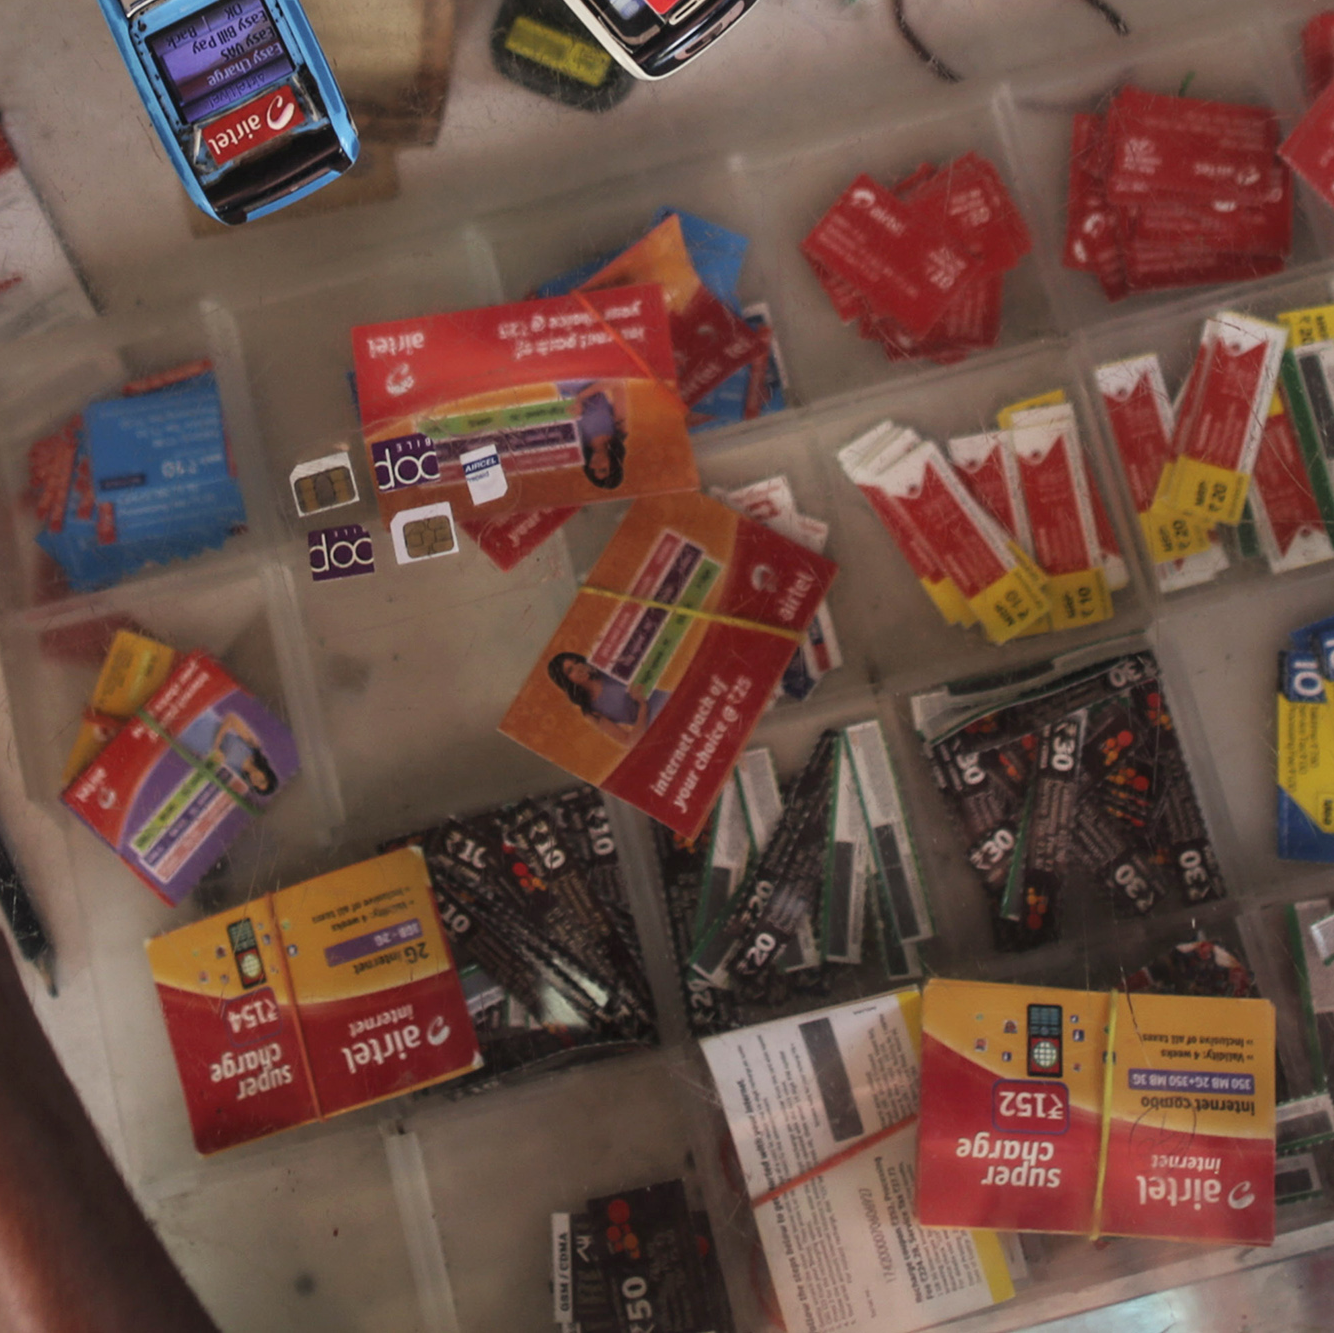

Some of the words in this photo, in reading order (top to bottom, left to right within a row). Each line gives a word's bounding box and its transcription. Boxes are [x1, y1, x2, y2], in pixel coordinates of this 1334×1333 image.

[223, 1, 243, 20] OK
[235, 9, 268, 33] Easy
[164, 24, 197, 49] Back
[189, 34, 215, 57] Pay
[214, 23, 236, 44] Bill
[243, 25, 276, 50] Easy
[218, 41, 244, 62] VAS
[251, 41, 284, 66] Easy
[205, 56, 252, 88] Charge
[235, 73, 266, 96] Airtel
[207, 113, 264, 154] airtel
[366, 331, 426, 360] airtel
[464, 456, 496, 472] AIRCEL
[774, 569, 815, 622] airtel
[1293, 659, 1321, 695] 10
[648, 731, 696, 797] internet
[684, 693, 718, 736] pack
[705, 674, 729, 698] of
[670, 769, 703, 813] your
[690, 717, 729, 772] choice
[719, 702, 741, 724] @
[73, 765, 110, 803] airtel
[352, 950, 403, 976] internet
[402, 940, 430, 964] 2G
[224, 996, 279, 1033] ₹154
[347, 1003, 415, 1037] internet
[341, 1023, 425, 1074] airtel
[1141, 1033, 1169, 1043] taxes
[1171, 1034, 1184, 1044] all
[1186, 1035, 1197, 1045] of
[1199, 1035, 1244, 1046] Inclusive
[207, 1040, 284, 1084] charge
[1160, 1048, 1191, 1059] weeks
[1193, 1049, 1199, 1059] 4
[1202, 1048, 1244, 1061] Validity:
[231, 1062, 293, 1100] super
[1132, 1072, 1147, 1084] 3G
[1149, 1073, 1166, 1085] MB
[1211, 1076, 1229, 1088] MB
[1231, 1076, 1251, 1089] 350
[998, 1090, 1063, 1119] ₹152
[1140, 1095, 1191, 1110] combo
[1195, 1097, 1254, 1115] internet
[955, 1131, 1054, 1164] charge
[980, 1160, 1060, 1189] super
[1151, 1154, 1220, 1173] internet
[1135, 1174, 1221, 1209] airtel
[557, 1231, 568, 1271] CDMA
[559, 1282, 569, 1311] GSM
